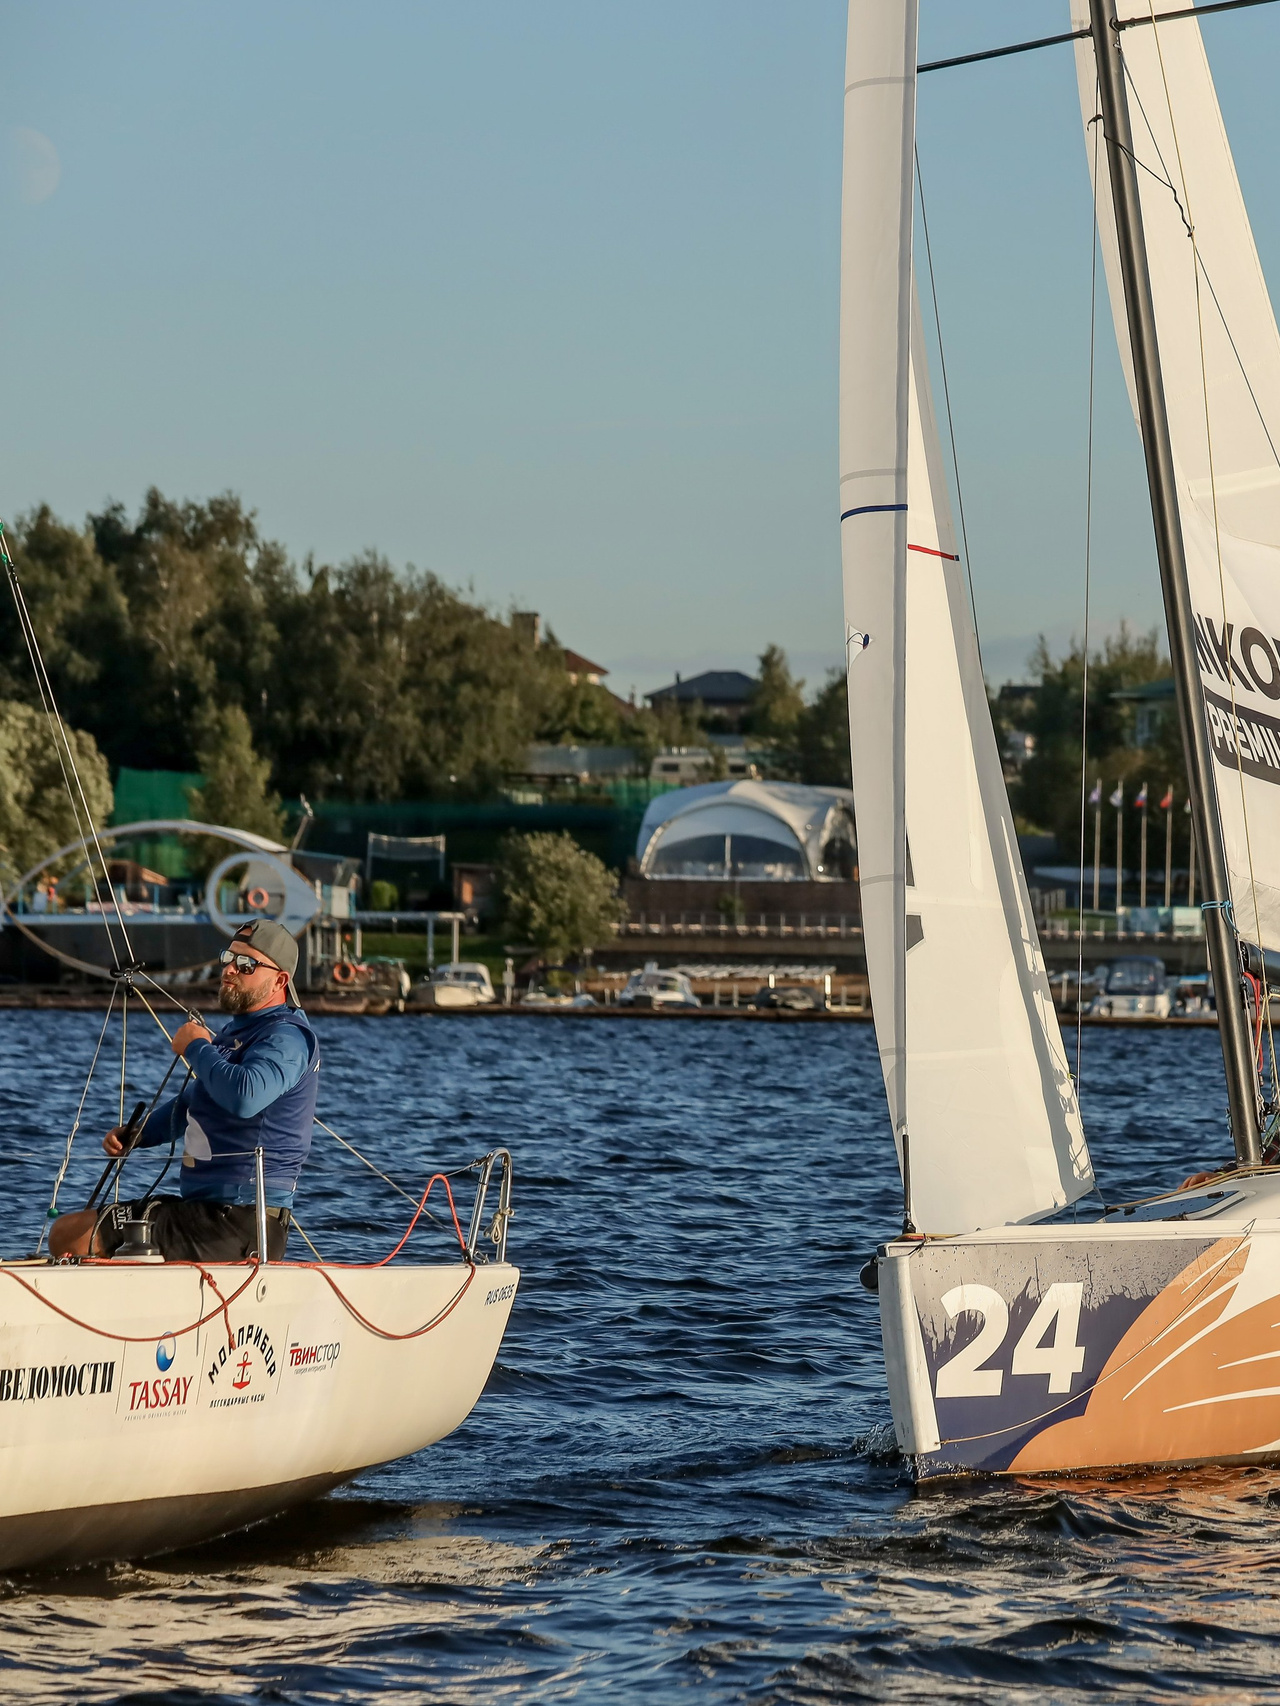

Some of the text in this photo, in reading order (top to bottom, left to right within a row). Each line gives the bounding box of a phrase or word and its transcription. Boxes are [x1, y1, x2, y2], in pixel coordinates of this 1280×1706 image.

[935, 1282, 1086, 1399] 24
[0, 1360, 116, 1405] ВЕДОМОСТИ
[129, 1375, 194, 1412] TASSAY
